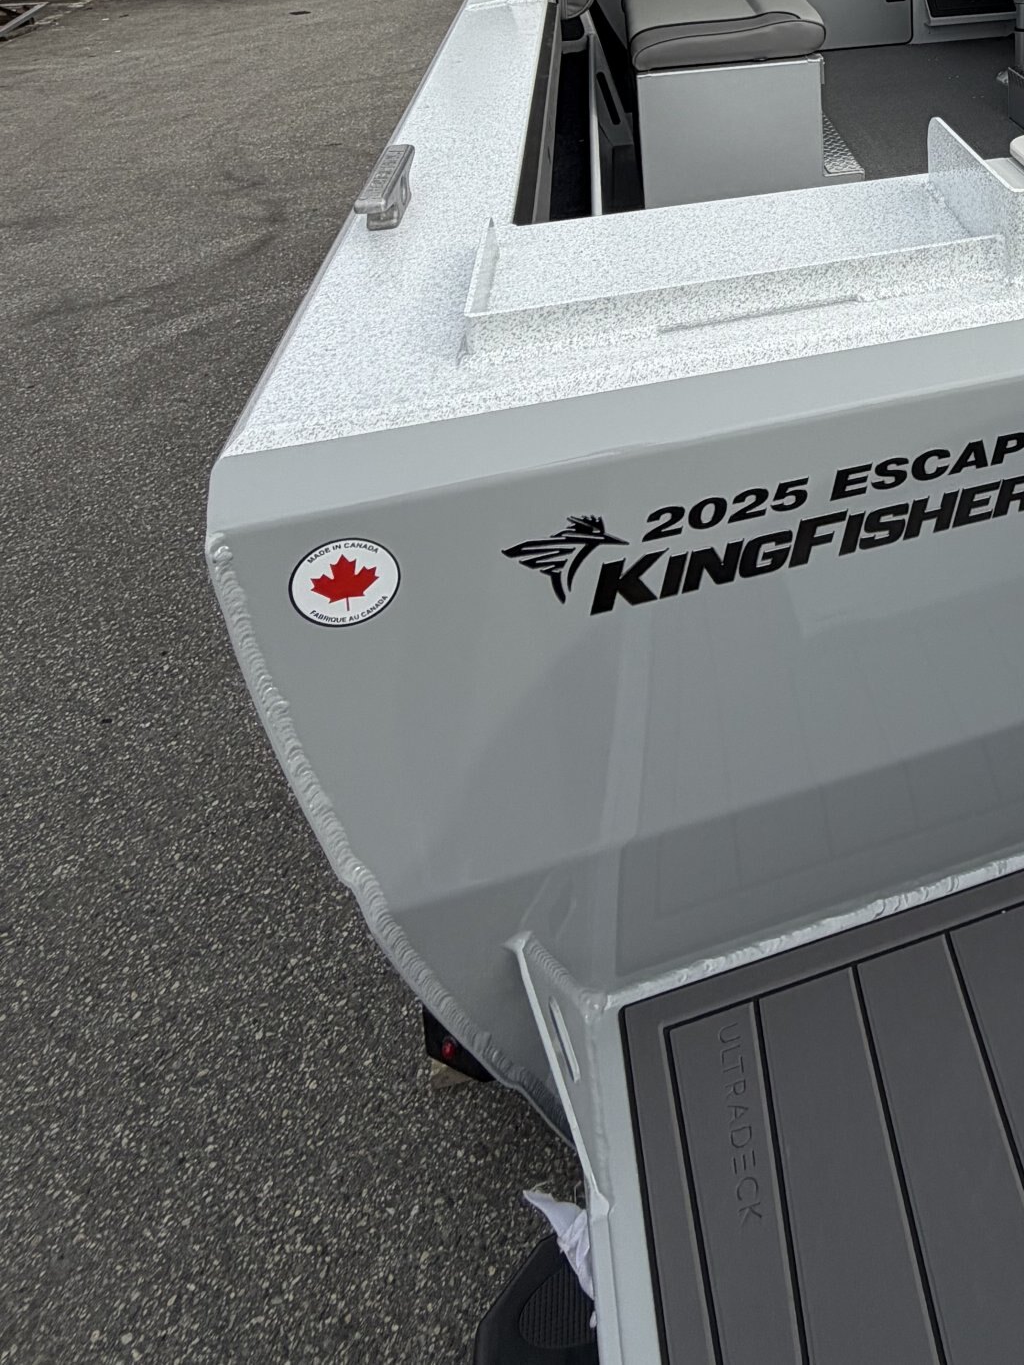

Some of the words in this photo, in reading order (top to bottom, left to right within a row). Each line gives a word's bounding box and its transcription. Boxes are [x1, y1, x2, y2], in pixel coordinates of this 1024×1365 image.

[642, 477, 810, 542] 2025
[307, 547, 331, 564] MADE
[332, 543, 342, 551] IN
[343, 542, 380, 554] CANADA
[309, 609, 347, 623] FABRIQUE
[348, 613, 360, 622] AU
[360, 595, 389, 618] CANADA
[717, 1021, 763, 1228] ULTRADECK
